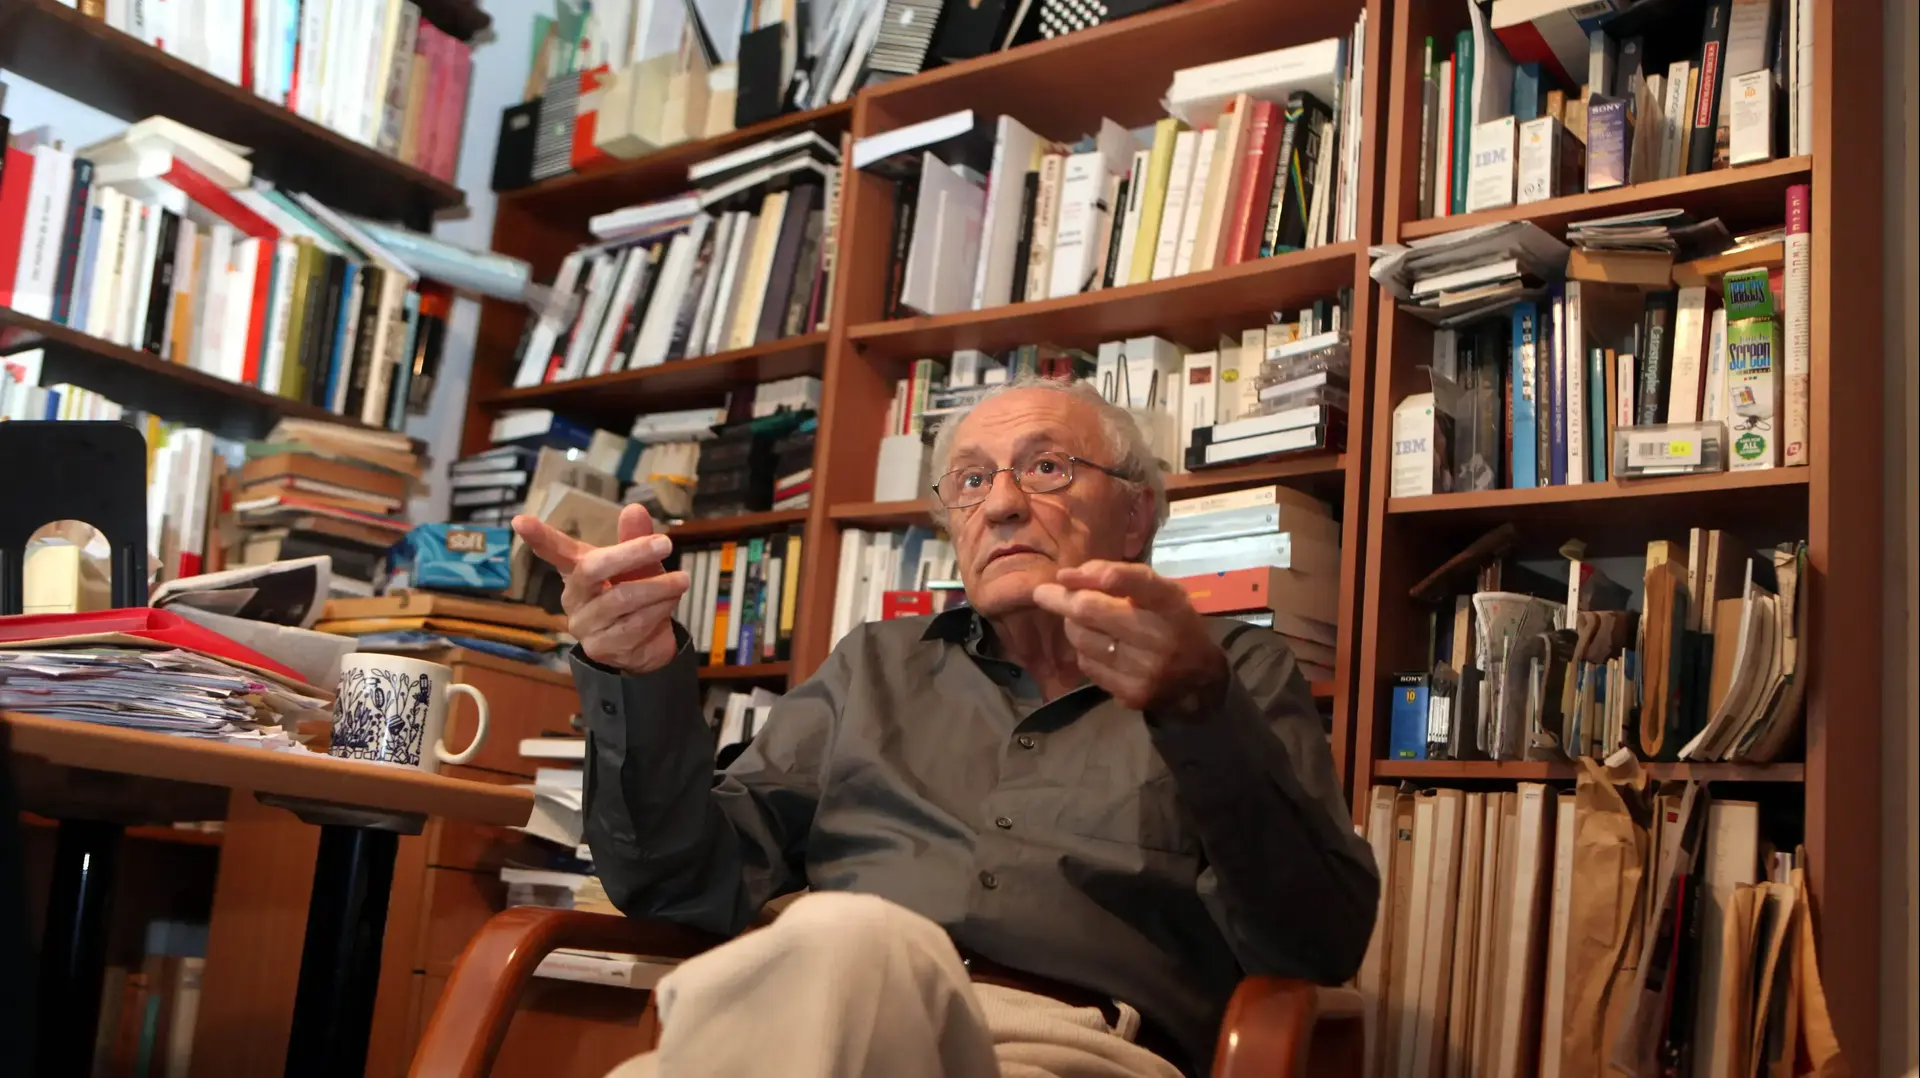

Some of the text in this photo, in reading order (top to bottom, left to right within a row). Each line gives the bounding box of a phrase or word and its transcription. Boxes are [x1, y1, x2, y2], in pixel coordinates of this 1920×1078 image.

[1592, 103, 1621, 113] SONY
[1475, 147, 1506, 168] IBM
[1645, 326, 1664, 395] Catastrophe
[1729, 343, 1771, 371] Screen
[1395, 438, 1427, 456] IBM
[1406, 691, 1416, 701] 10
